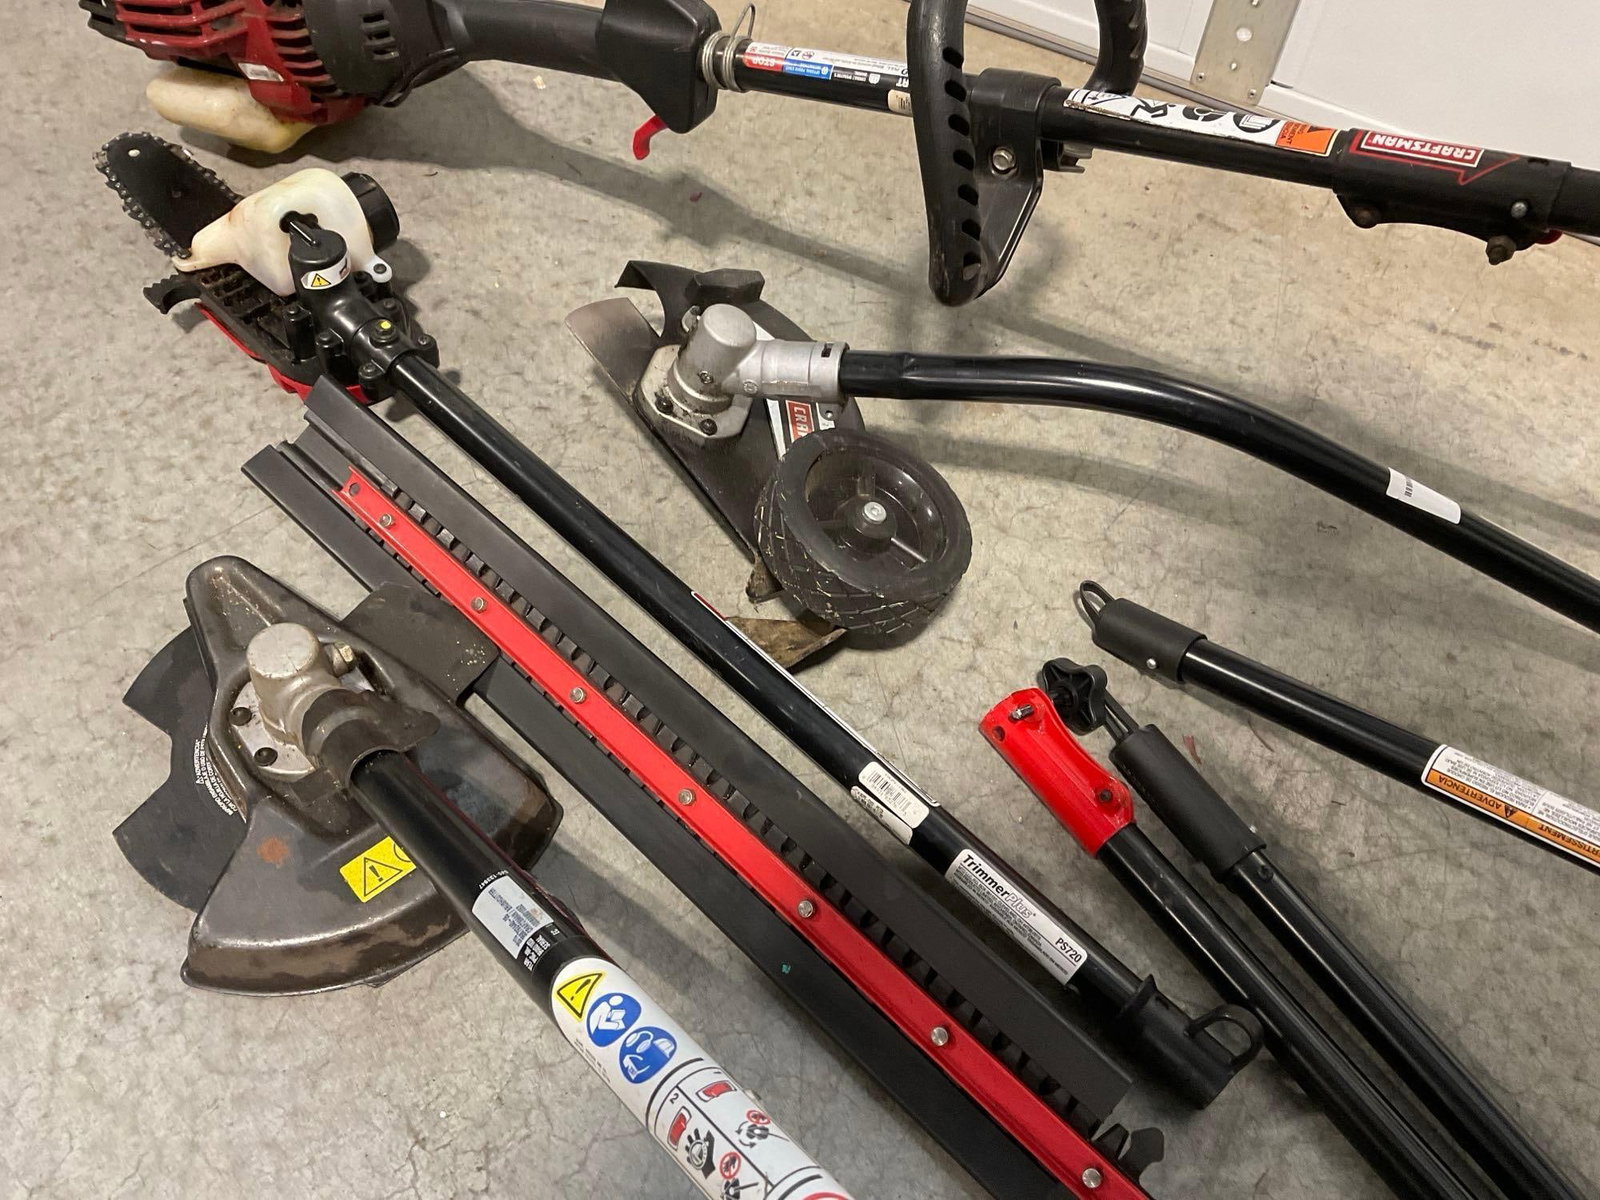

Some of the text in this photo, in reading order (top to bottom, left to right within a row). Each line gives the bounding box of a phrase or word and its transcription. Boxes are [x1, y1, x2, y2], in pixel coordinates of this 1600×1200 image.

[751, 57, 775, 66] STOP
[1373, 133, 1476, 160] CRAFTSMAN
[1437, 775, 1502, 810] ADVERTENCIA
[1054, 937, 1083, 963] PS720
[668, 1094, 679, 1104] 2
